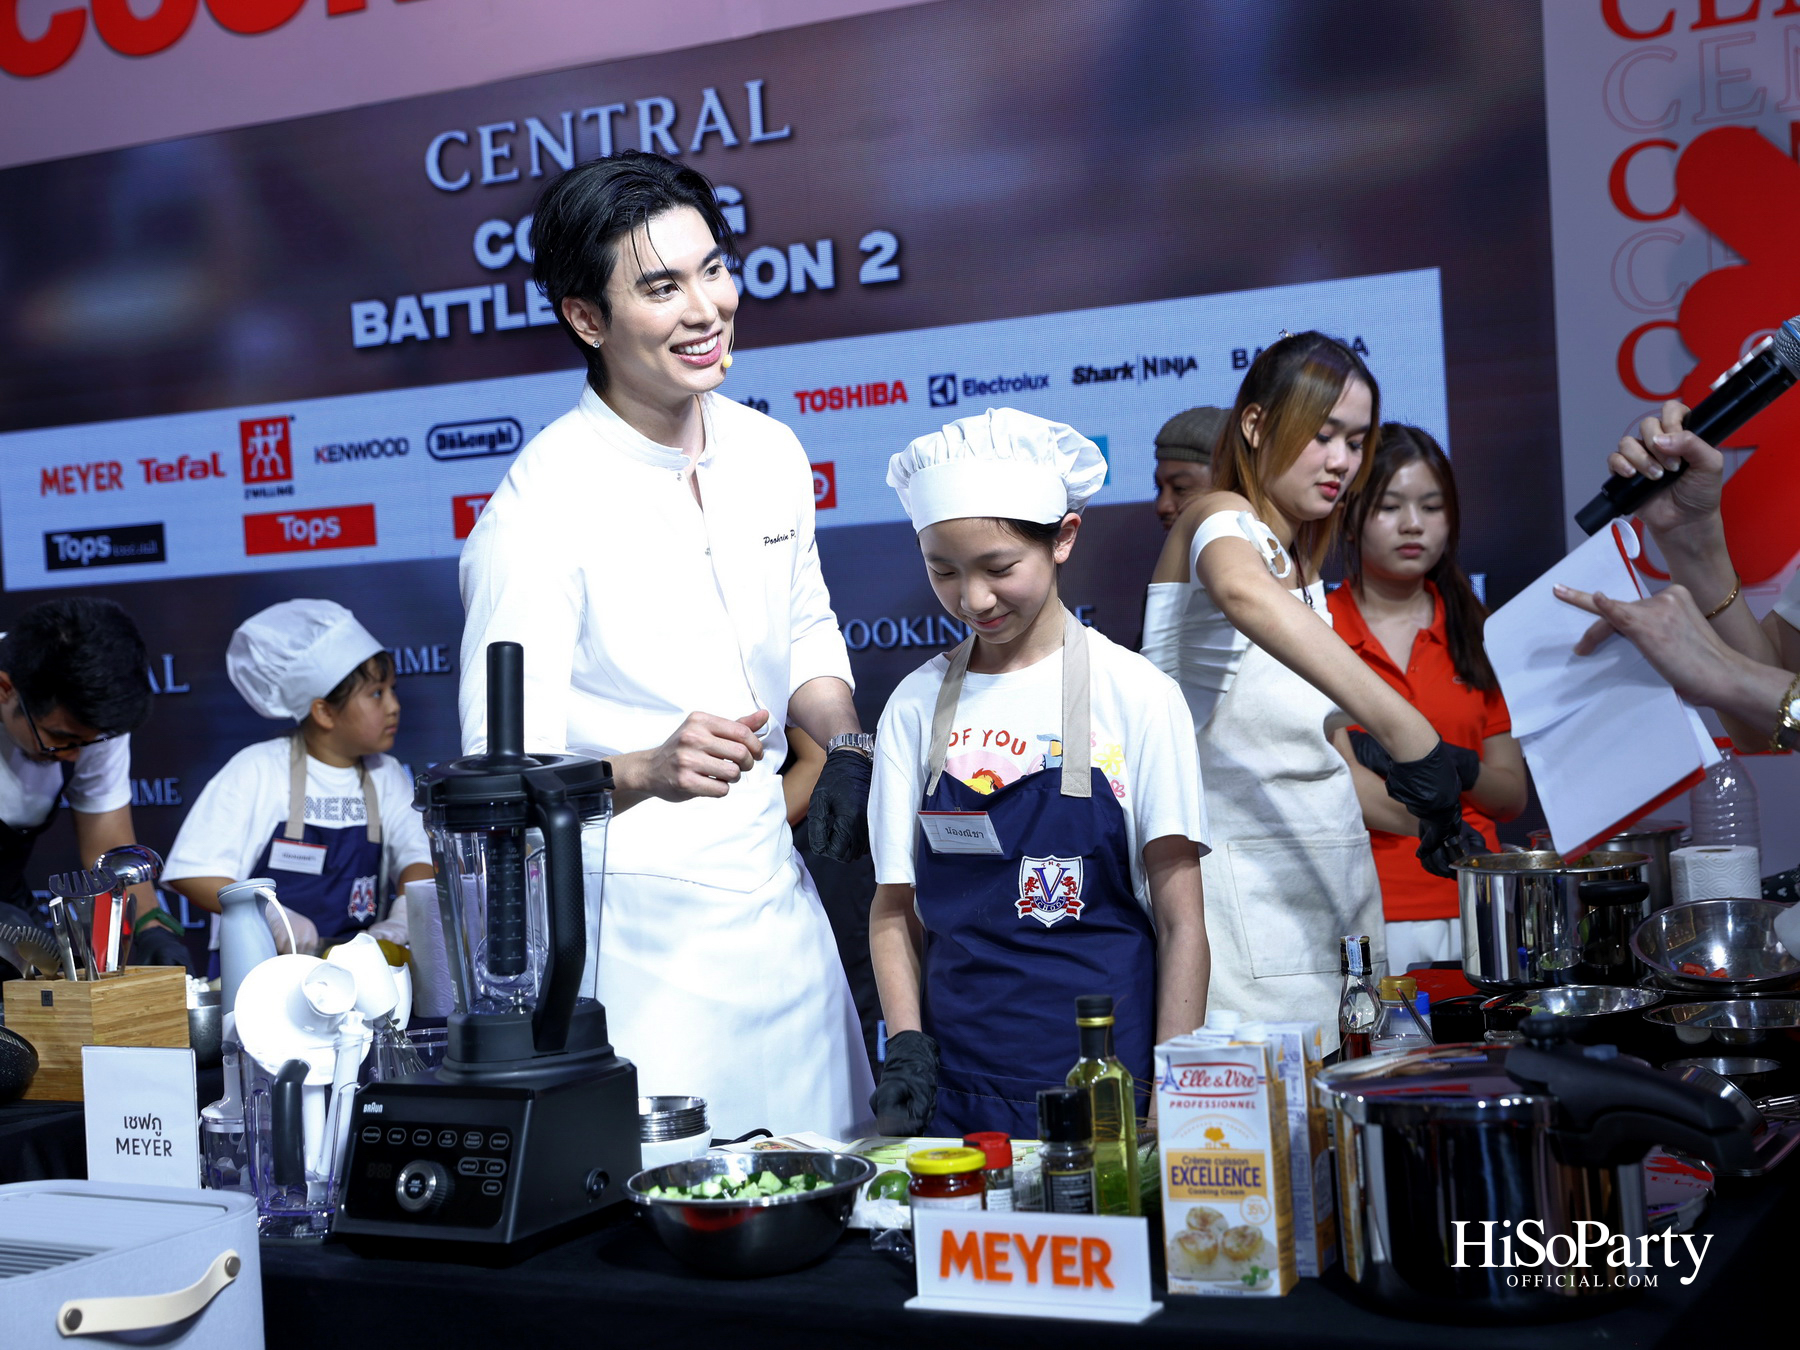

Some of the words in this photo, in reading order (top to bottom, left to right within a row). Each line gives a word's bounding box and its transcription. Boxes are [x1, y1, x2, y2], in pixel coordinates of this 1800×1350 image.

[1602, 24, 1800, 134] CE
[424, 79, 791, 191] CENTRAL
[352, 279, 559, 348] BATTLE
[859, 230, 899, 285] 2
[40, 461, 124, 497] MEYER
[138, 452, 226, 485] Tefal
[244, 484, 296, 501] ZWILLING
[314, 436, 409, 464] KENWOOD
[795, 380, 908, 414] TOSHIBA
[962, 373, 1049, 397] Electrolux
[1072, 361, 1134, 385] Shark
[1143, 355, 1198, 381] NINJA
[277, 514, 341, 546] Tops
[51, 534, 112, 566] Tops
[838, 614, 972, 650] OOKIN
[982, 729, 1027, 755] YOU
[1032, 867, 1071, 903] V
[363, 1102, 384, 1114] BRAUN
[1169, 1101, 1256, 1110] PROFESSIONNEL
[123, 1112, 162, 1137] เชฟภู
[115, 1137, 172, 1157] MEYER
[1181, 1155, 1211, 1166] Crème
[1214, 1157, 1249, 1167] cuisson
[1171, 1166, 1262, 1188] EXCELLENCE
[1187, 1187, 1219, 1197] Cooking
[1220, 1188, 1245, 1197] Cream
[939, 1229, 1115, 1289] MEYER
